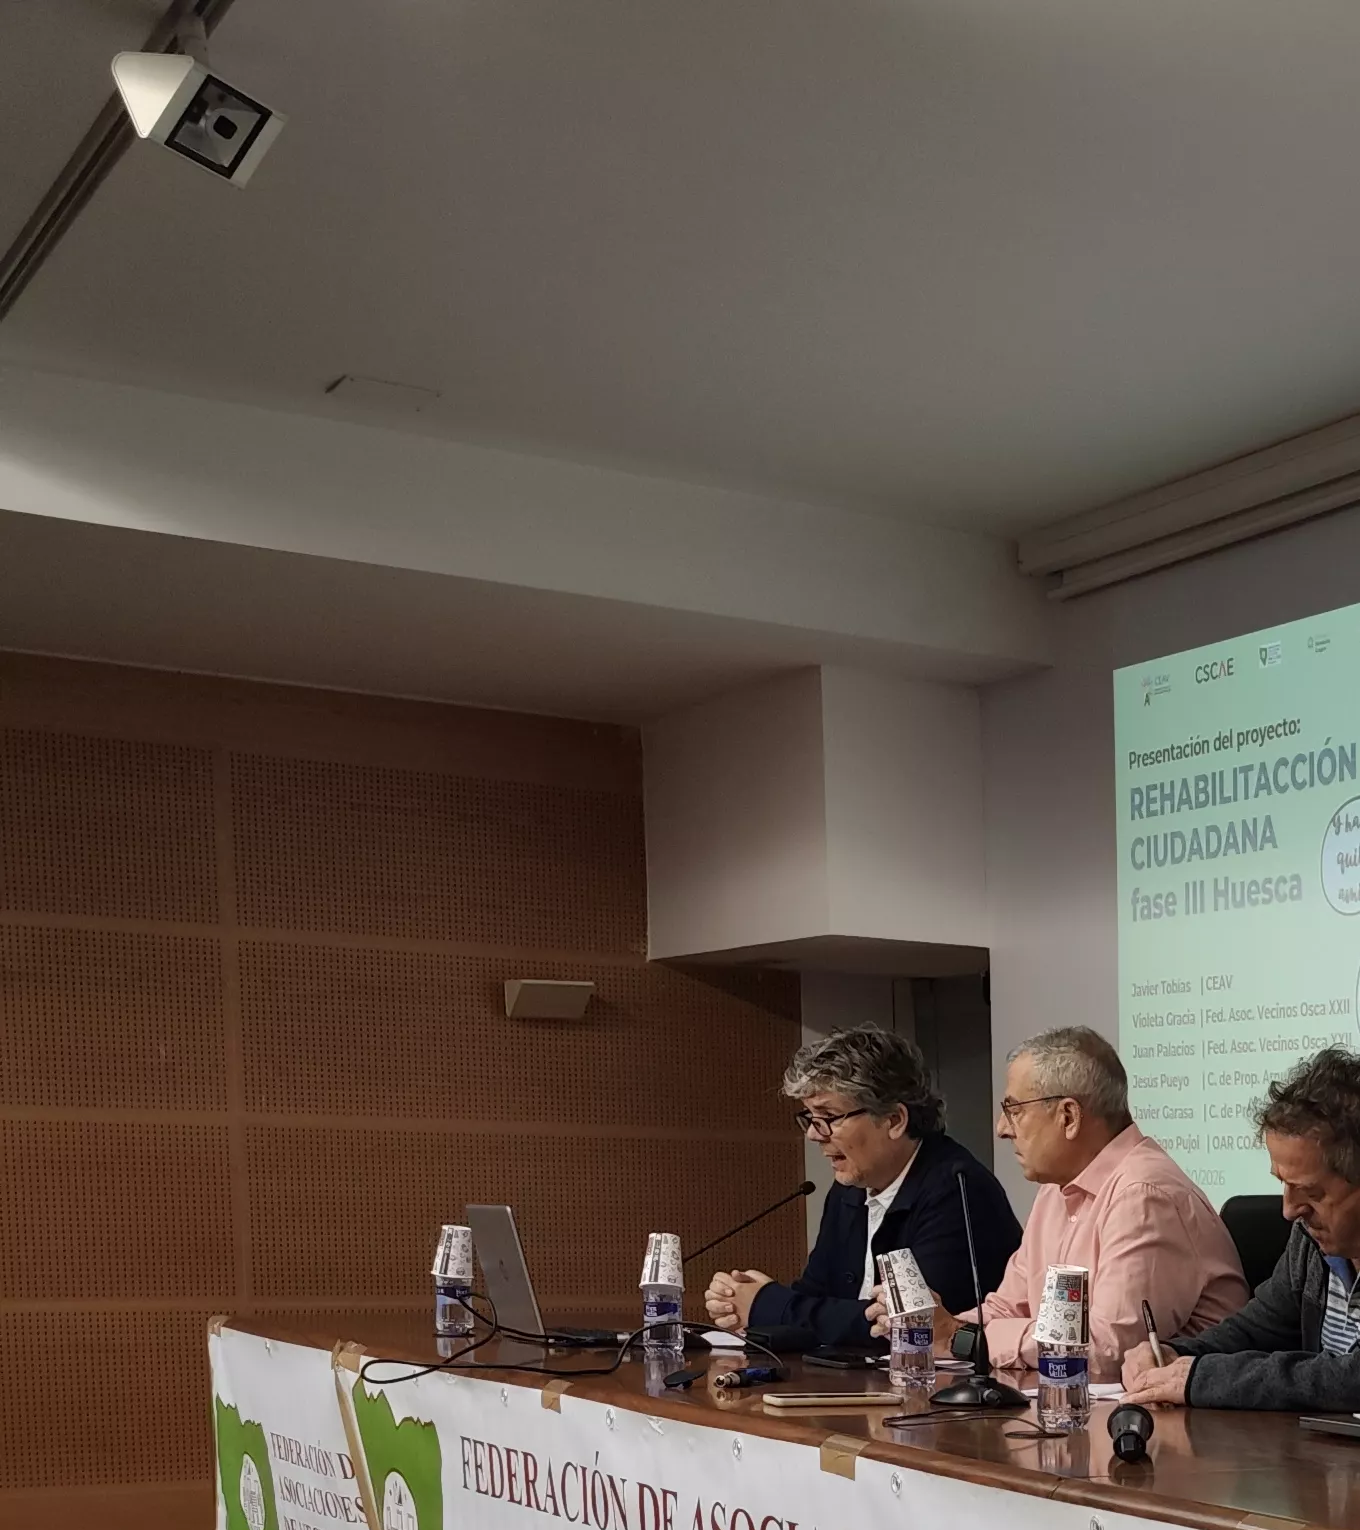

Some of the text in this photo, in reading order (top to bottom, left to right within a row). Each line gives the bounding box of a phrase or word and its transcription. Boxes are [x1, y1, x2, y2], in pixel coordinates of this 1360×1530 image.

[1128, 718, 1301, 769] Presentación del proyecto:
[1130, 736, 1357, 821] REHABILITACCIÓN
[1130, 814, 1278, 871] CIUDADANA
[1131, 872, 1303, 922] fase III Huesca
[1131, 980, 1158, 997] Javier
[1205, 975, 1233, 991] CEAV
[1132, 1009, 1195, 1028] Violeta Gracia
[1205, 998, 1351, 1023] Fed. Asoc. Vecinos Osca XXII
[1132, 1041, 1195, 1059] Juan Palacios
[1207, 1039, 1228, 1055] Fed.
[1230, 1038, 1257, 1054] Asoc.
[1259, 1034, 1299, 1052] Vecinos
[1302, 1034, 1328, 1050] Osca
[1160, 1073, 1189, 1091] Pueyo
[1219, 1070, 1231, 1086] de
[1233, 1070, 1260, 1088] Prop.
[1133, 1104, 1194, 1120] Javier Garasa
[1220, 1103, 1233, 1119] de
[1175, 1133, 1200, 1153] Pujol
[1212, 1135, 1234, 1150] OAR
[269, 1431, 336, 1478] FEDERACIÓN
[278, 1475, 367, 1523] ASOCIACIONES
